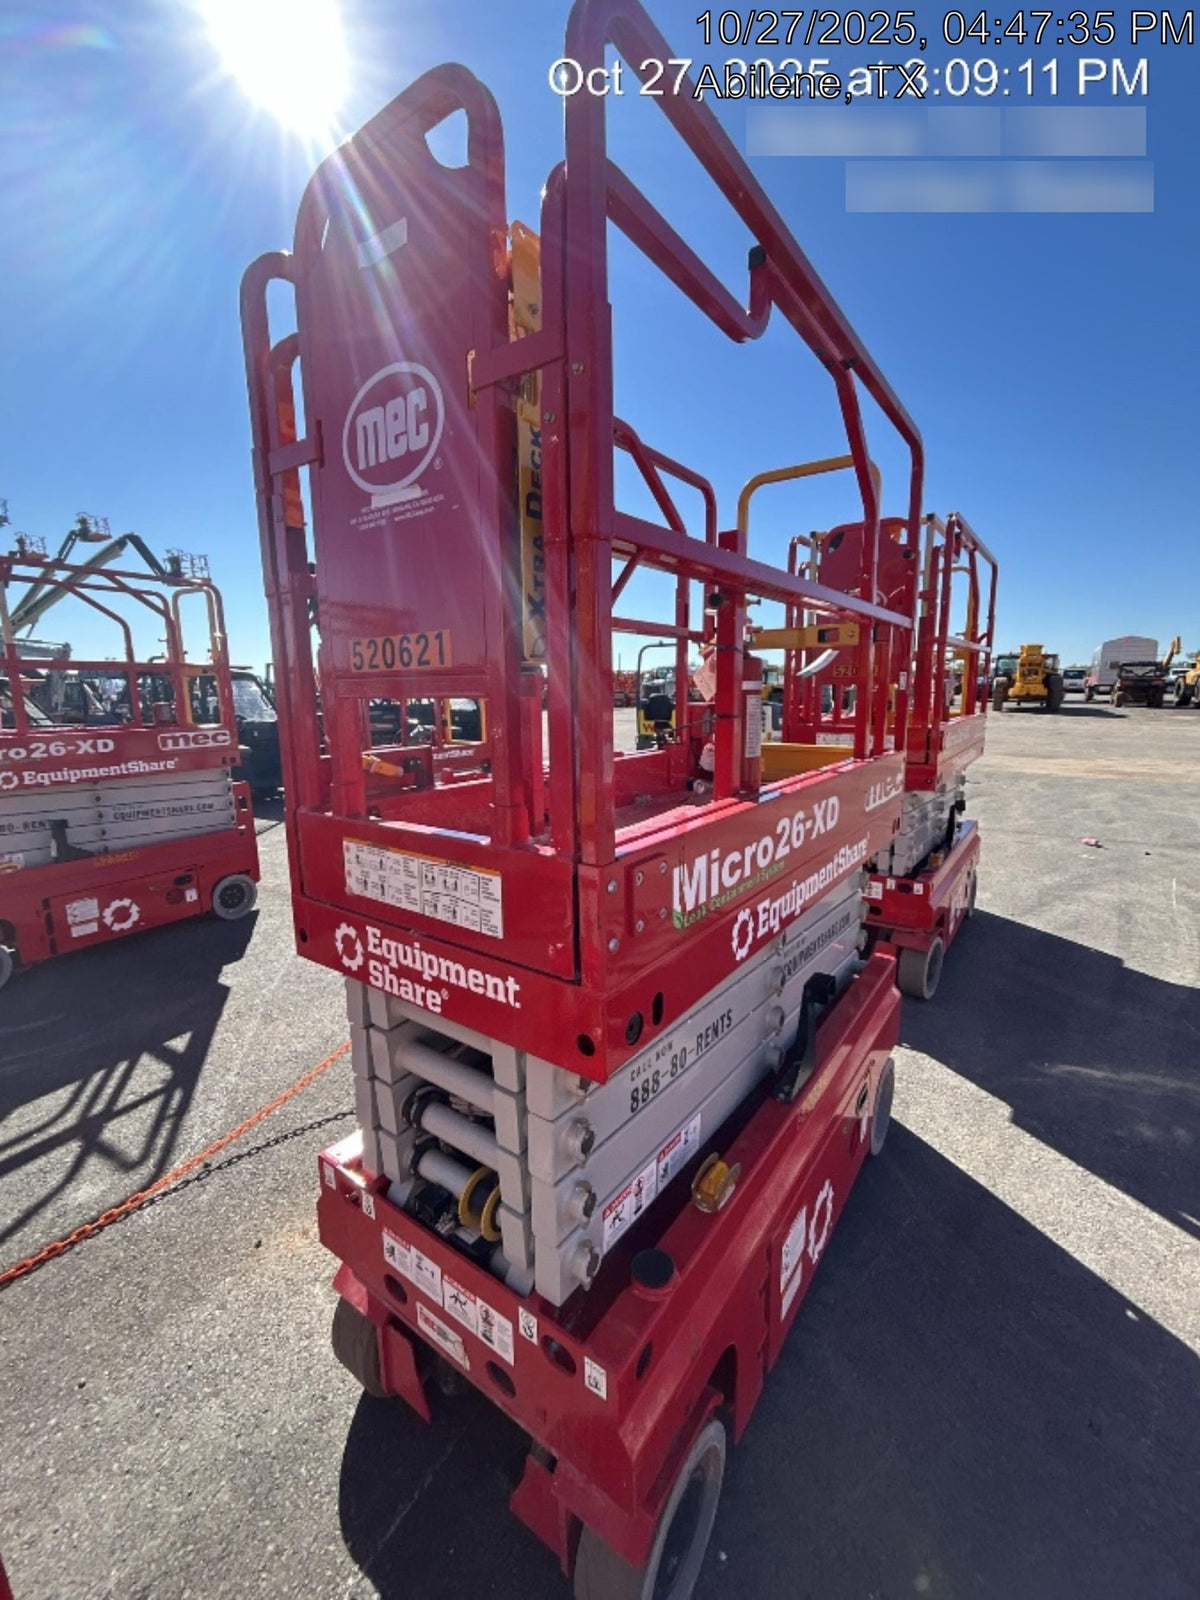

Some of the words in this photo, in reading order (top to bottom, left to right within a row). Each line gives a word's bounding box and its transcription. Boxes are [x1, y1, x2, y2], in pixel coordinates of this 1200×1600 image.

[352, 631, 446, 671] 520621
[22, 760, 177, 786] EquipmentShare
[672, 795, 840, 914] Micro26-XD
[756, 838, 869, 939] EquipmentShare
[630, 1008, 733, 1113] 888-80-RENTS
